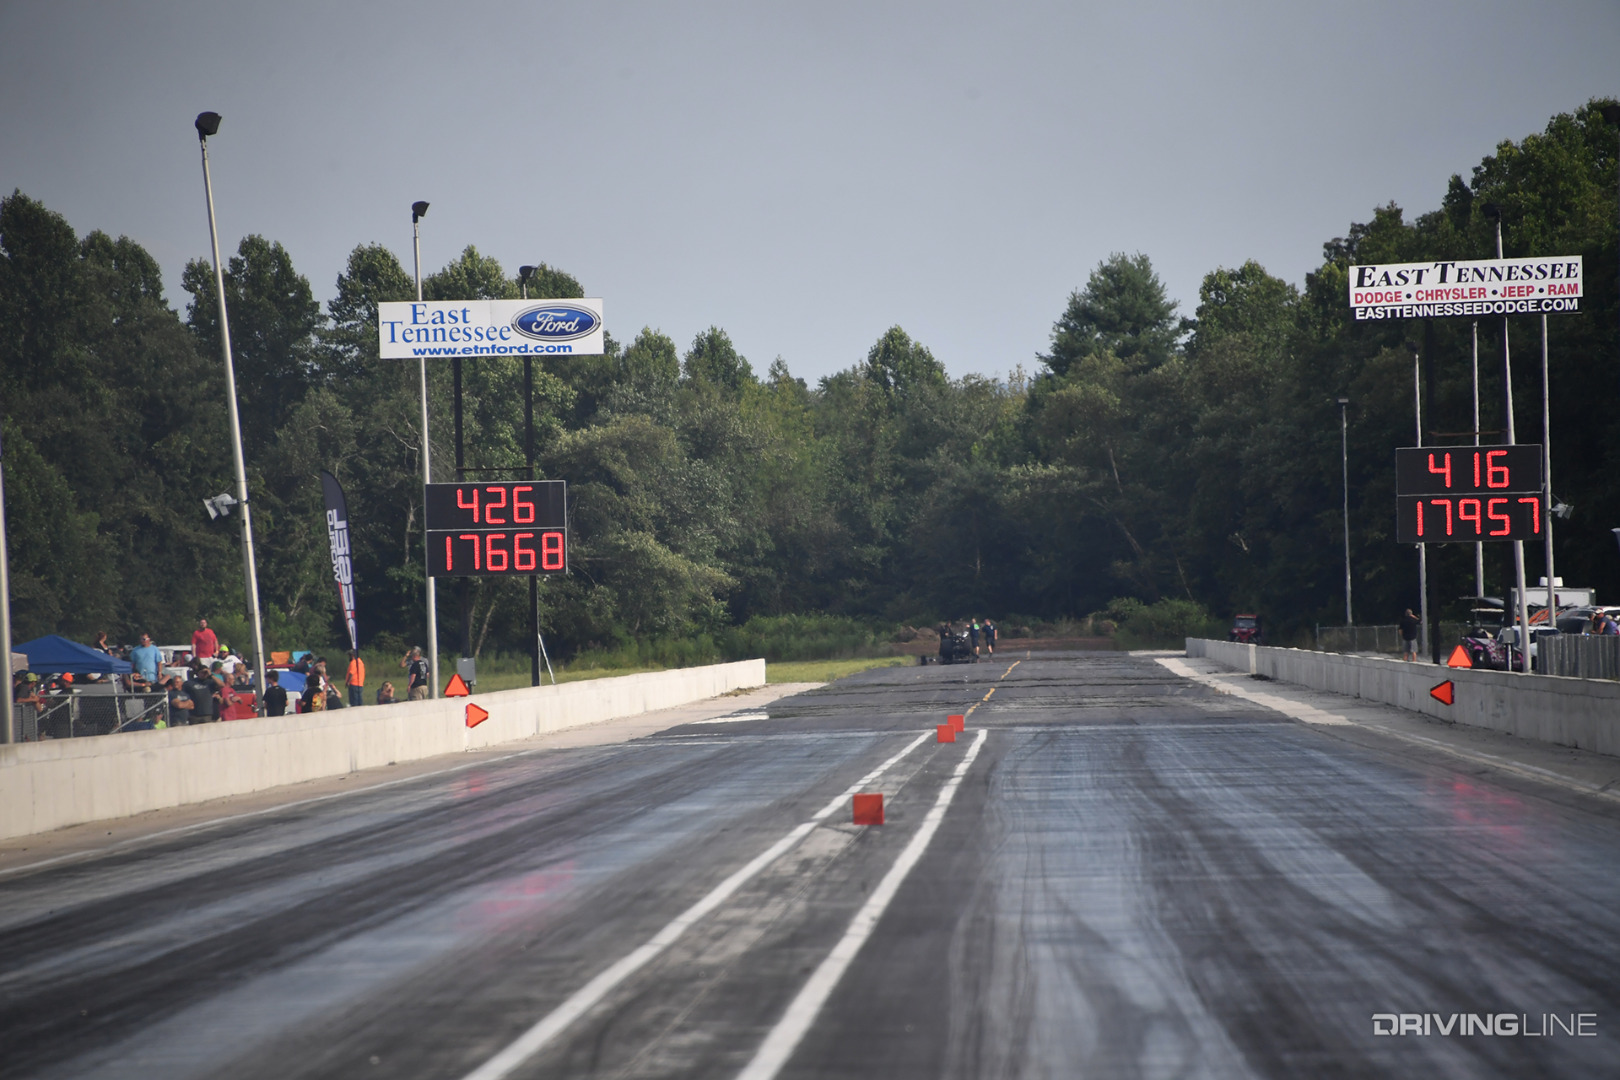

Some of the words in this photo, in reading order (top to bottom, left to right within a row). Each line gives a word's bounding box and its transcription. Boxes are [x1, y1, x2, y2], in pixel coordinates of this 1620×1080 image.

[1354, 291, 1403, 304] DODGE
[1415, 287, 1487, 301] CHRYSLER
[1500, 285, 1535, 298] JEEP
[1547, 283, 1578, 296] RAM
[409, 304, 471, 325] East
[1355, 298, 1578, 320] EASTTENNESSEEDODGE.COM
[382, 321, 511, 344] Tennessee
[531, 311, 581, 333] Ford
[412, 344, 572, 356] www.etnford.com
[457, 486, 535, 524] 426
[1417, 497, 1539, 537] 17957
[446, 532, 564, 571] 17668
